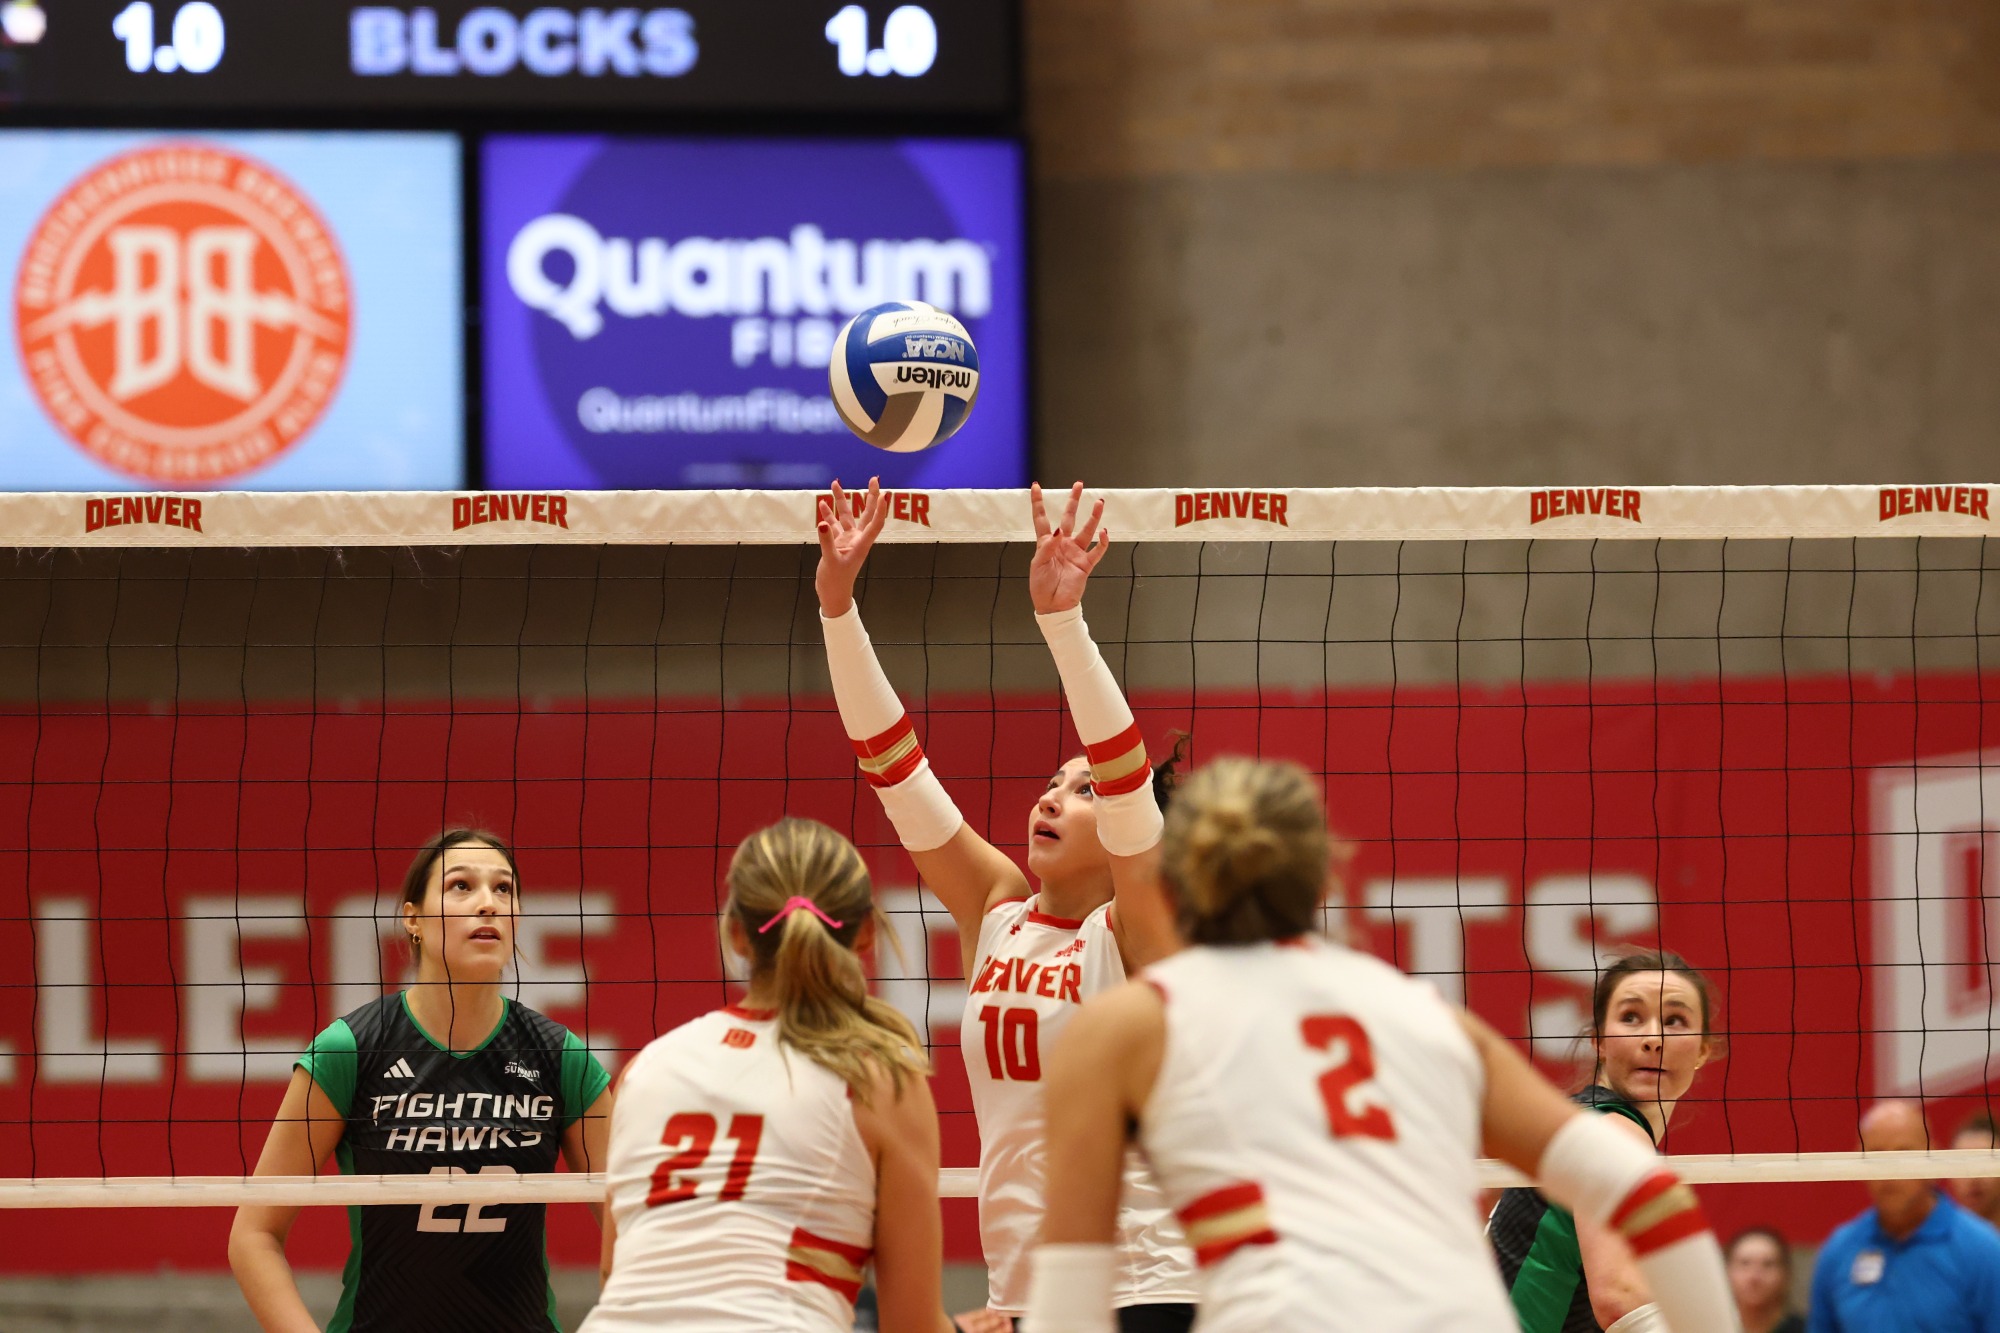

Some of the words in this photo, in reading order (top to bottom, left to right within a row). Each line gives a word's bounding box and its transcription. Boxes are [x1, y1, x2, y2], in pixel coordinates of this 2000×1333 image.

[112, 1, 226, 73] 1.0
[349, 6, 699, 77] BLOCKS
[825, 4, 938, 77] 1.0
[507, 213, 992, 340] Quantum
[731, 317, 838, 368] FIB
[906, 336, 965, 363] NCAA
[897, 361, 971, 389] molten
[85, 496, 204, 534] DENVER
[452, 494, 570, 532] DENVER
[1174, 491, 1289, 528] DENVER
[1530, 488, 1642, 524] DENVER
[1879, 486, 1990, 522] DENVER
[979, 1004, 1042, 1082] 10
[1298, 1012, 1399, 1143] 2
[370, 1092, 554, 1127] FIGHTING
[385, 1126, 543, 1152] HAWKS
[645, 1112, 766, 1209] 21
[416, 1165, 519, 1233] 22
